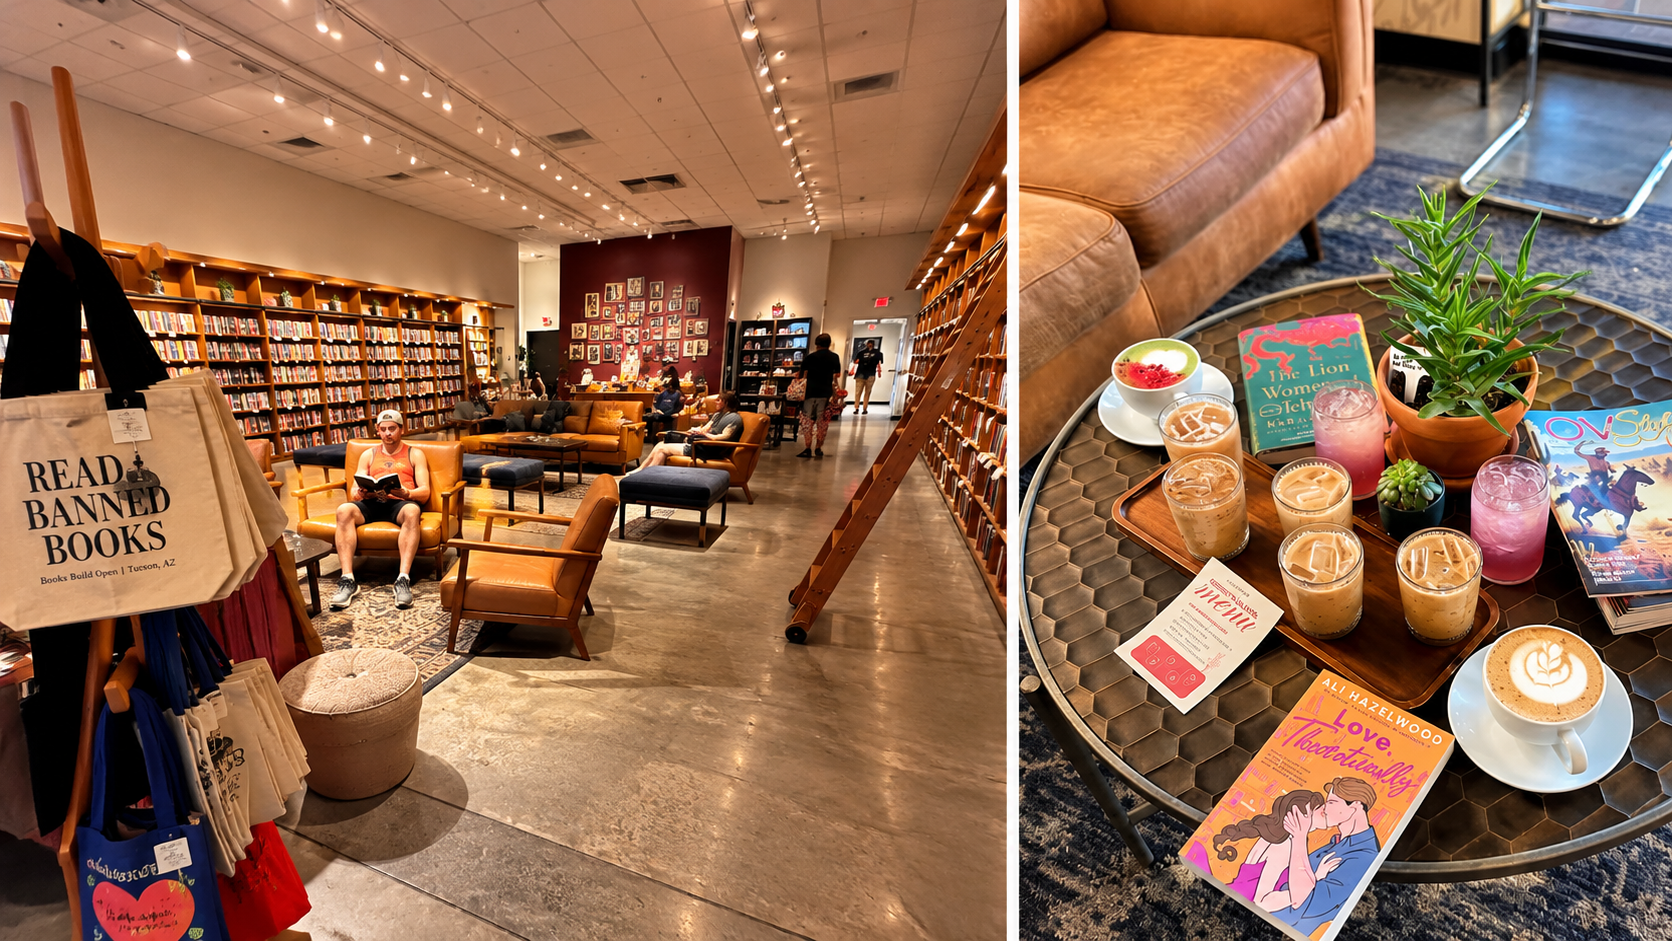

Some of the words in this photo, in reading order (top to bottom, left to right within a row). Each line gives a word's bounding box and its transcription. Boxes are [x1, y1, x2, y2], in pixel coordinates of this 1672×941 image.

[1308, 363, 1350, 377] Lion
[22, 454, 124, 493] READ
[22, 485, 171, 530] BANNED
[41, 520, 167, 566] BOOKS
[40, 575, 68, 585] Books
[95, 568, 118, 579] Open
[127, 562, 161, 573] Tucson,
[162, 558, 176, 568] AZ
[1194, 583, 1257, 633] menu
[1321, 677, 1346, 694] ALI
[1348, 690, 1443, 745] HAZELWOOD
